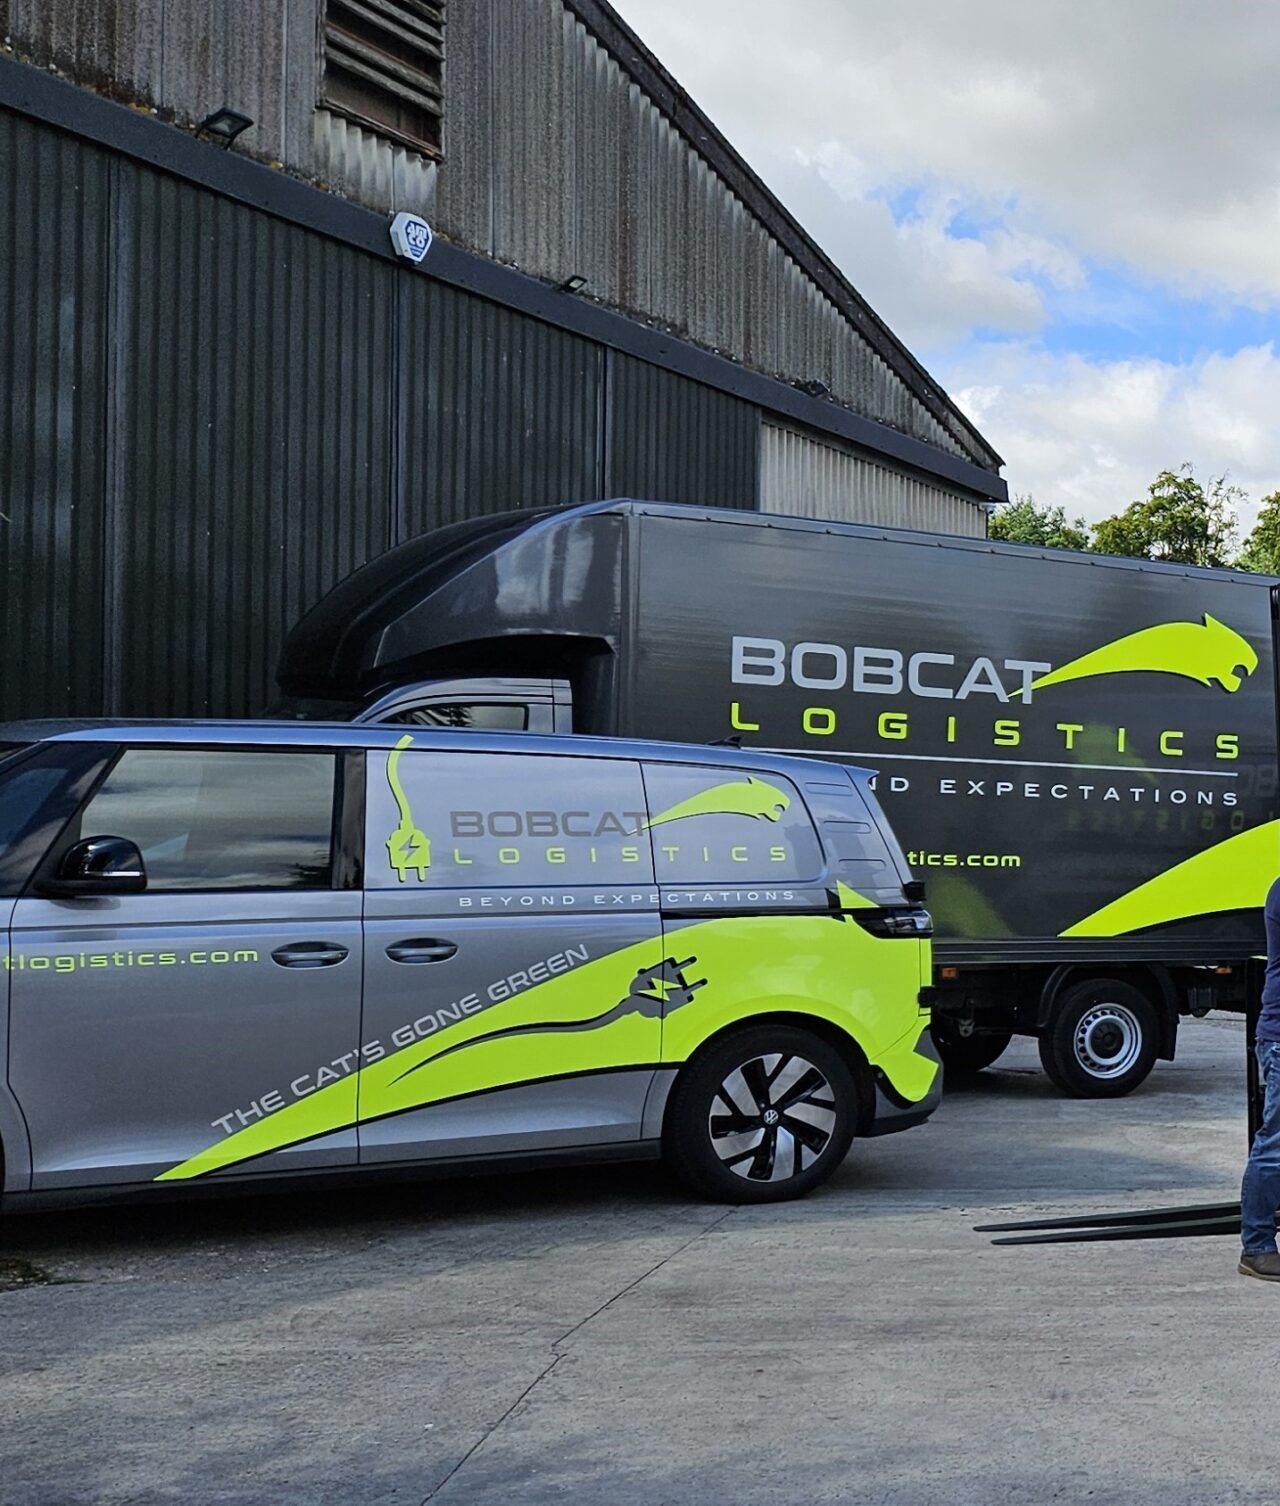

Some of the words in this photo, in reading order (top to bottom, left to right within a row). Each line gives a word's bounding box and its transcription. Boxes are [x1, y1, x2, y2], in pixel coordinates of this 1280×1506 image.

[731, 635, 1052, 705] BOBCAT
[730, 702, 1240, 760] LOGISTICS
[940, 779, 1238, 806] EXPECTATIONS
[450, 811, 652, 838] BOBCAT
[453, 847, 786, 864] LOGISTICS
[459, 895, 575, 907] BEYOND
[594, 891, 794, 905] EXPECTATIONS
[211, 1090, 285, 1134] THE
[290, 1039, 386, 1097] CAT'S
[391, 993, 482, 1047] GONE
[487, 944, 590, 1001] GREEN
